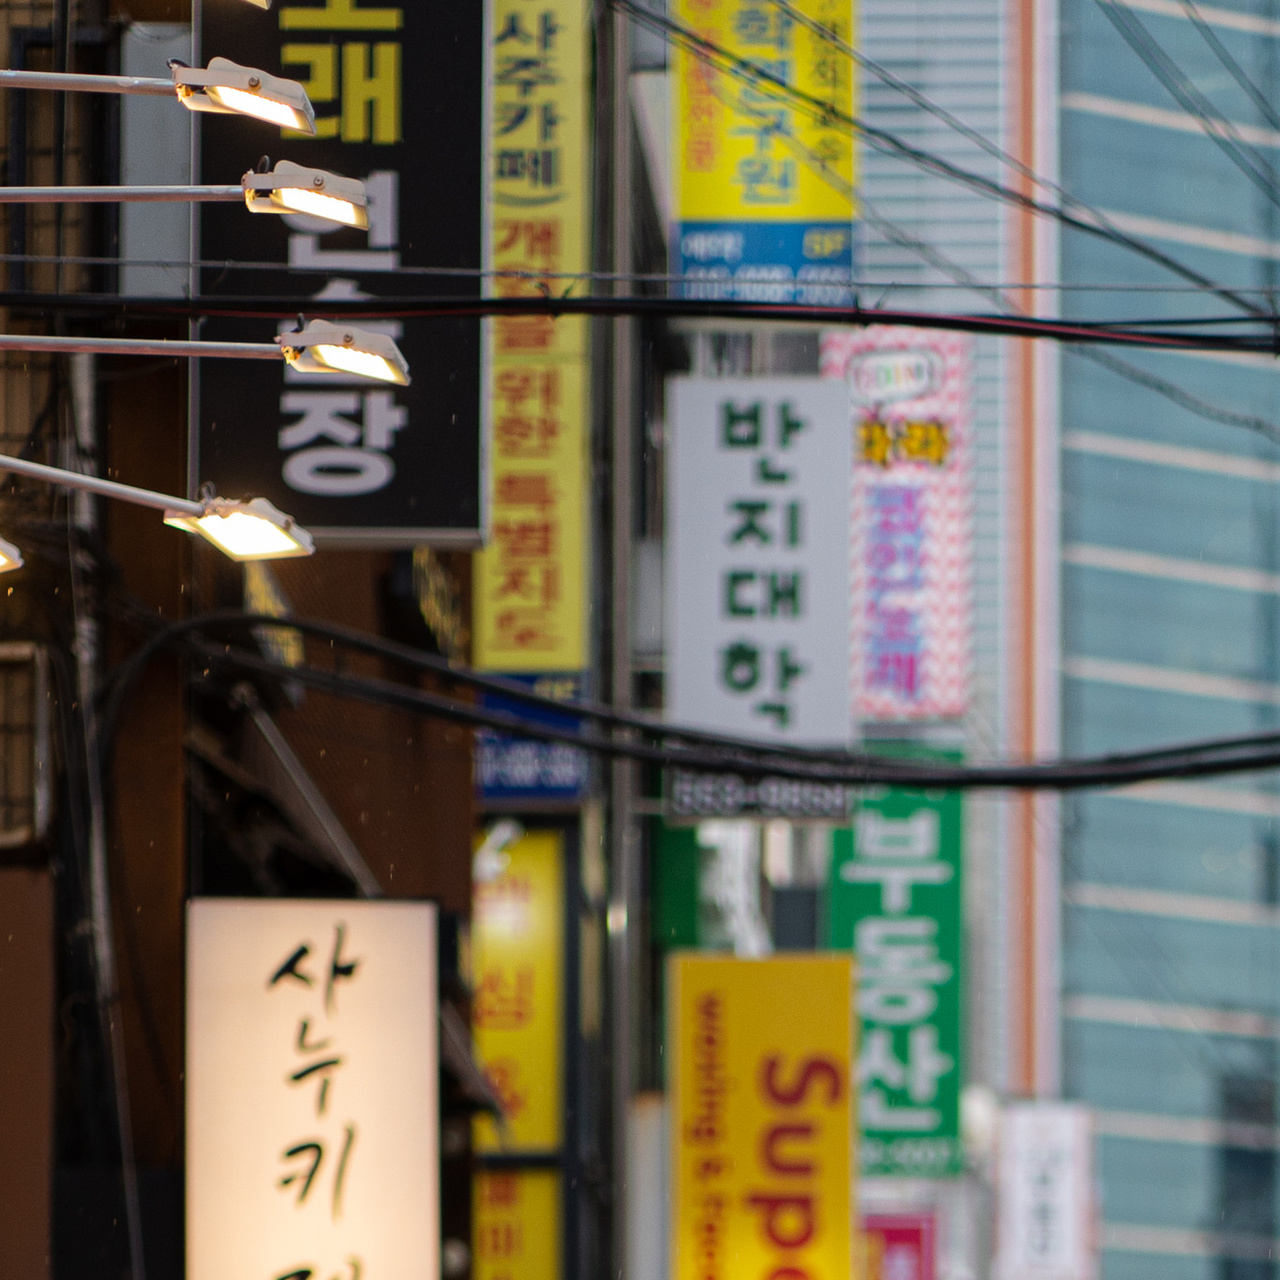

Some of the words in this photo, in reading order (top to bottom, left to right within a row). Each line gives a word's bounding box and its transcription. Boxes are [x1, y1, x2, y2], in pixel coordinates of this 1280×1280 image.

[720, 398, 808, 730] 반지대학
[268, 921, 366, 1225] 사누키
[841, 806, 954, 1133] 부동산
